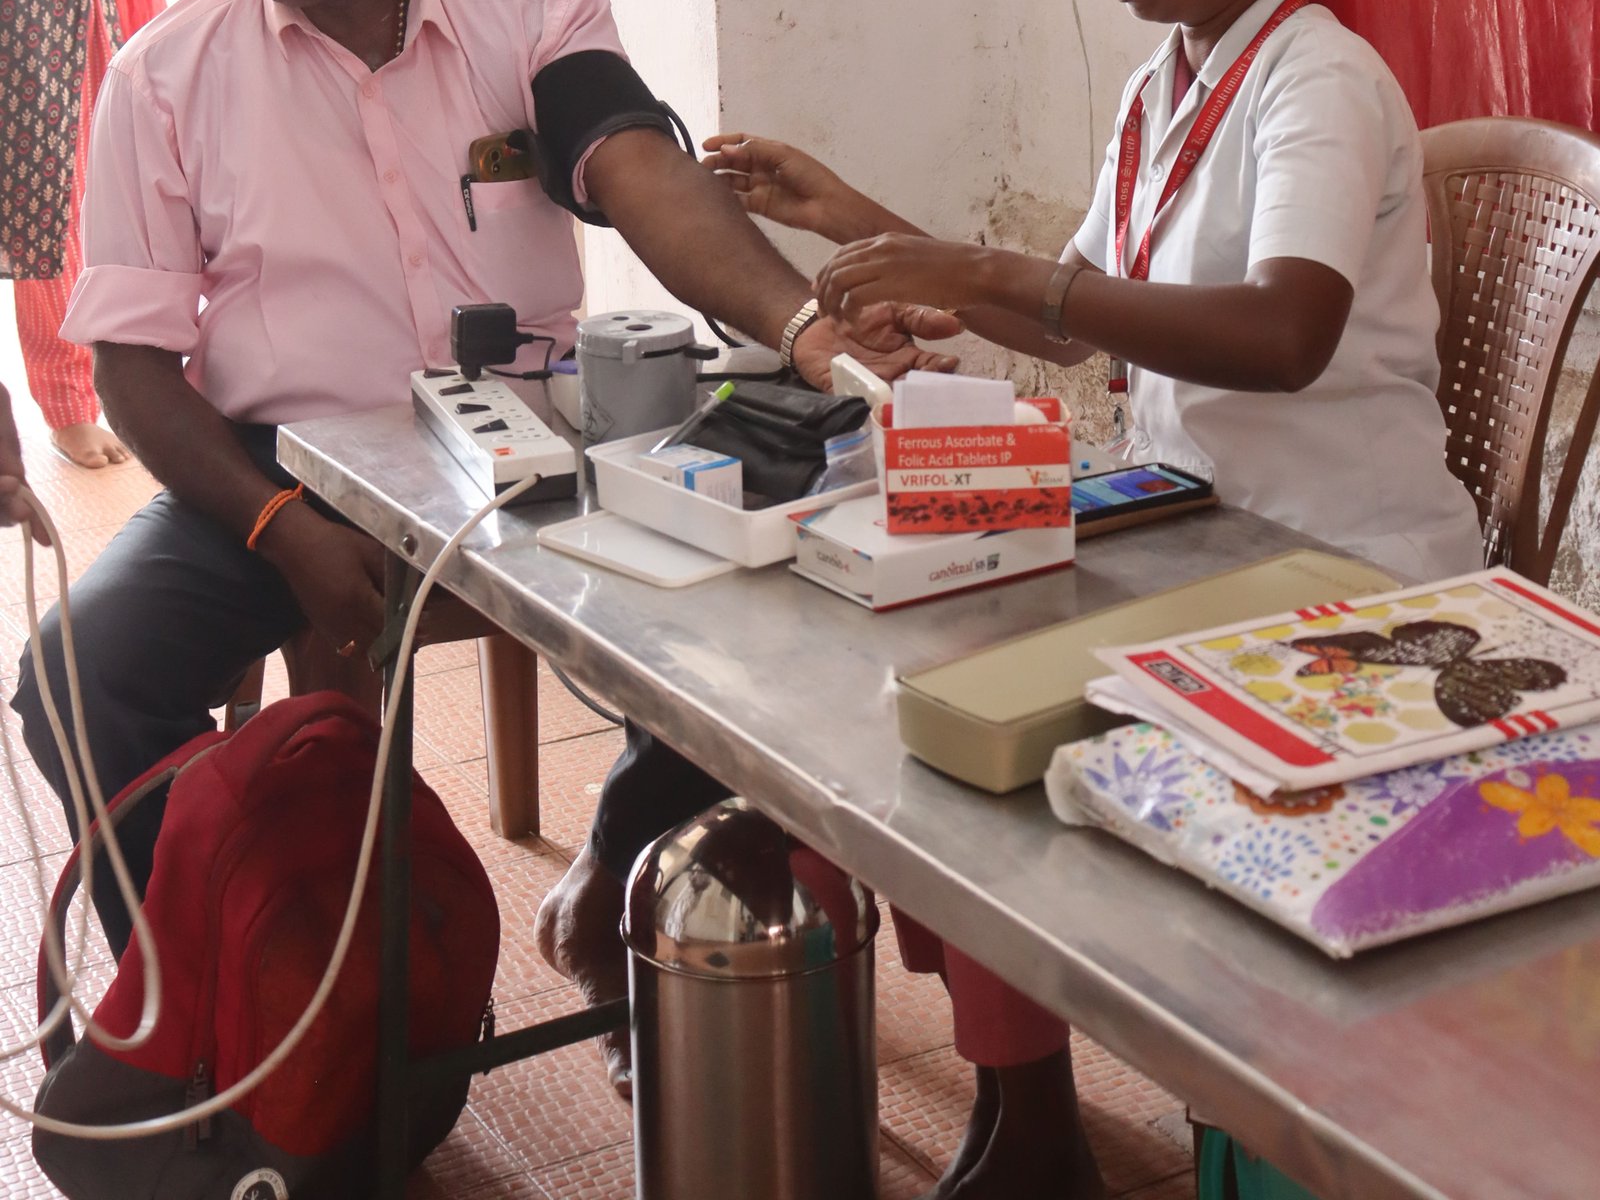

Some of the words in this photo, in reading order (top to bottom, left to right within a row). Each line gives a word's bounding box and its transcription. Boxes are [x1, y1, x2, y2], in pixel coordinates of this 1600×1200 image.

[897, 436, 943, 450] Ferrous
[944, 433, 1004, 449] Ascorbate
[1006, 432, 1017, 446] &
[898, 453, 926, 467] Folic
[928, 452, 954, 467] Acid
[956, 451, 998, 466] Tablets
[1000, 451, 1013, 464] IP
[900, 472, 973, 487] VRIFOL-XT
